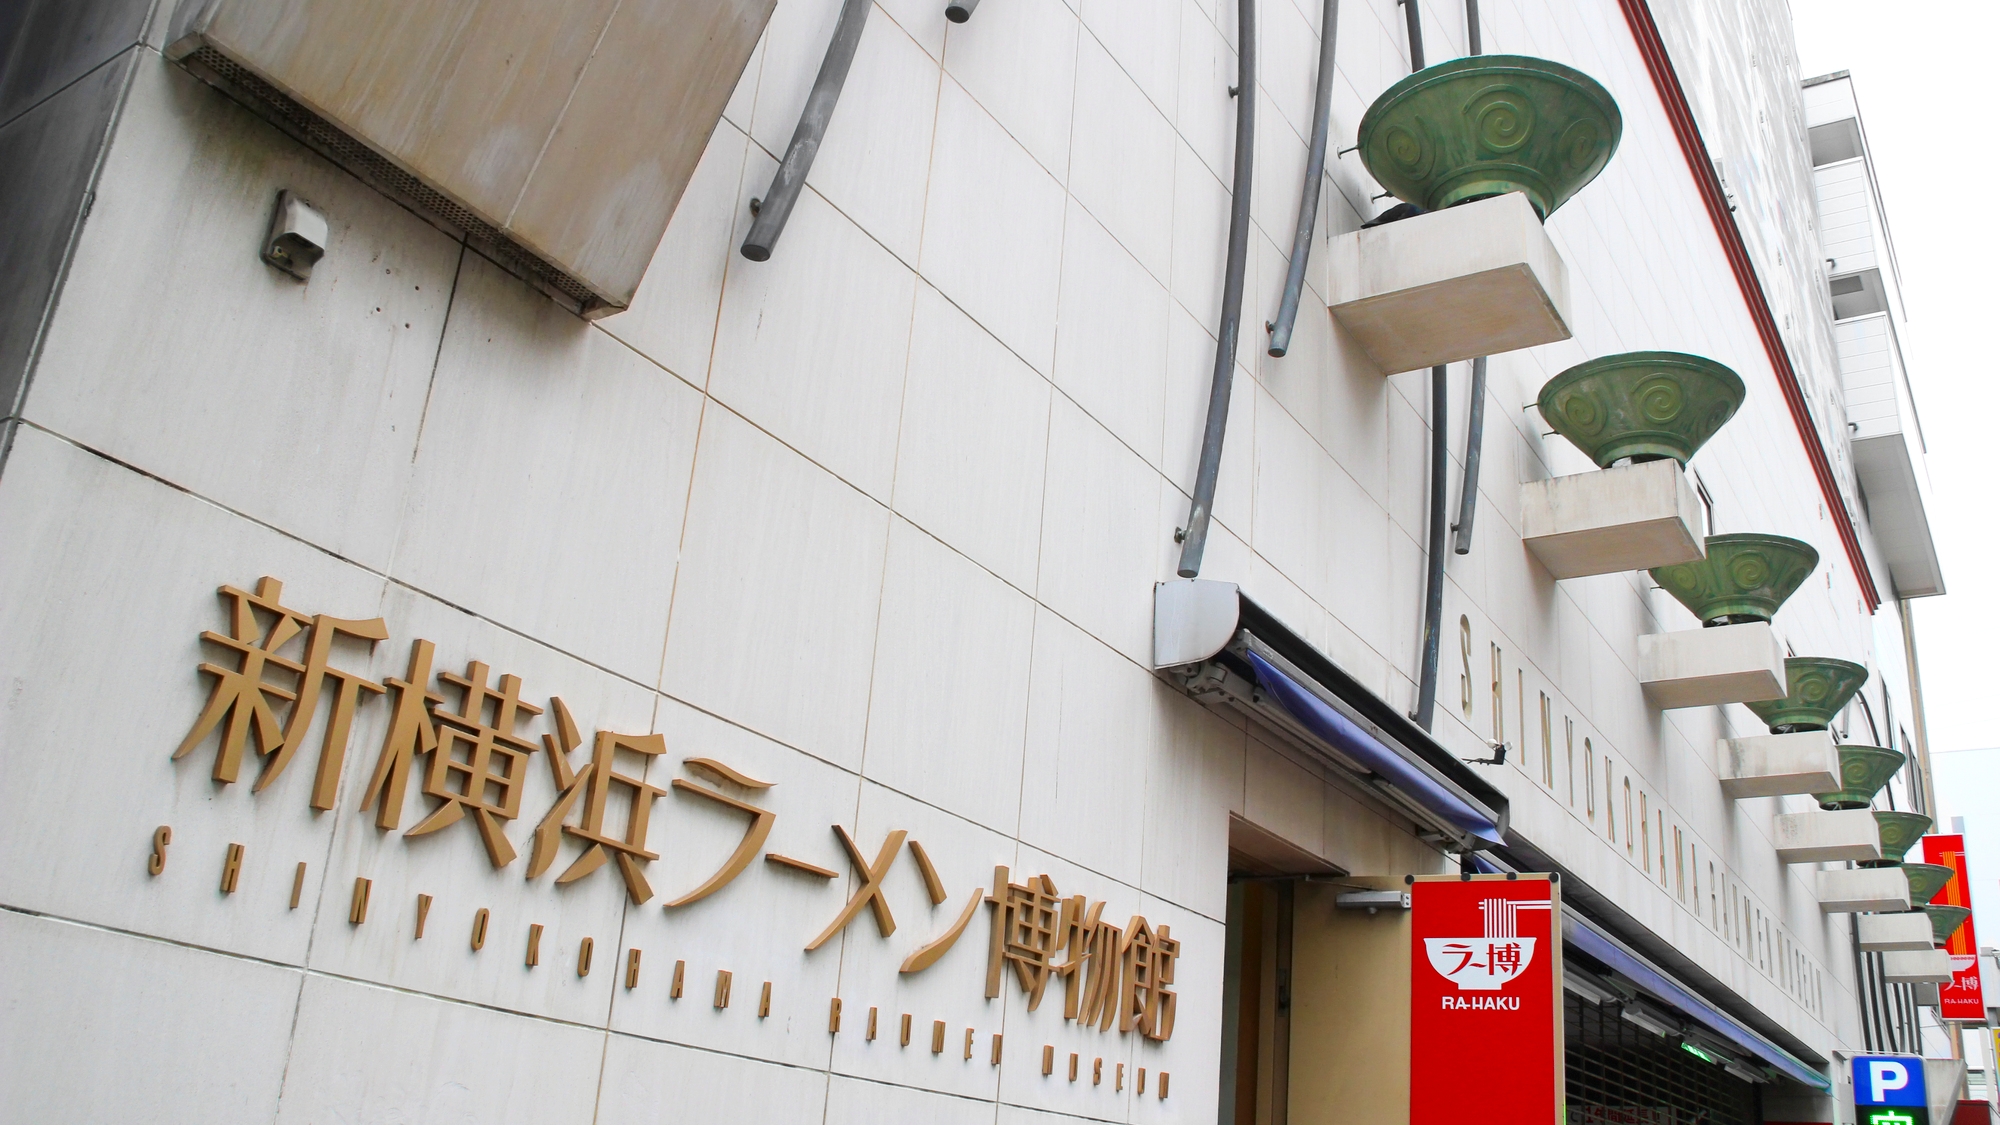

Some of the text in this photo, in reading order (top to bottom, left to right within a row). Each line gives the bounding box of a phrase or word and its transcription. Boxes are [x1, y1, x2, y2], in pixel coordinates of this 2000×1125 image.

[171, 575, 1181, 1042] 新横浜ラーメン博物館
[1459, 613, 1825, 1023] SHINYOKOHAMA RAUMEN MUSEUM
[148, 825, 1170, 1100] SHINYOKOHAMA RAUMEN MUSEUM
[1441, 996, 1521, 1011] RA-HAKU
[1868, 1060, 1909, 1103] P
